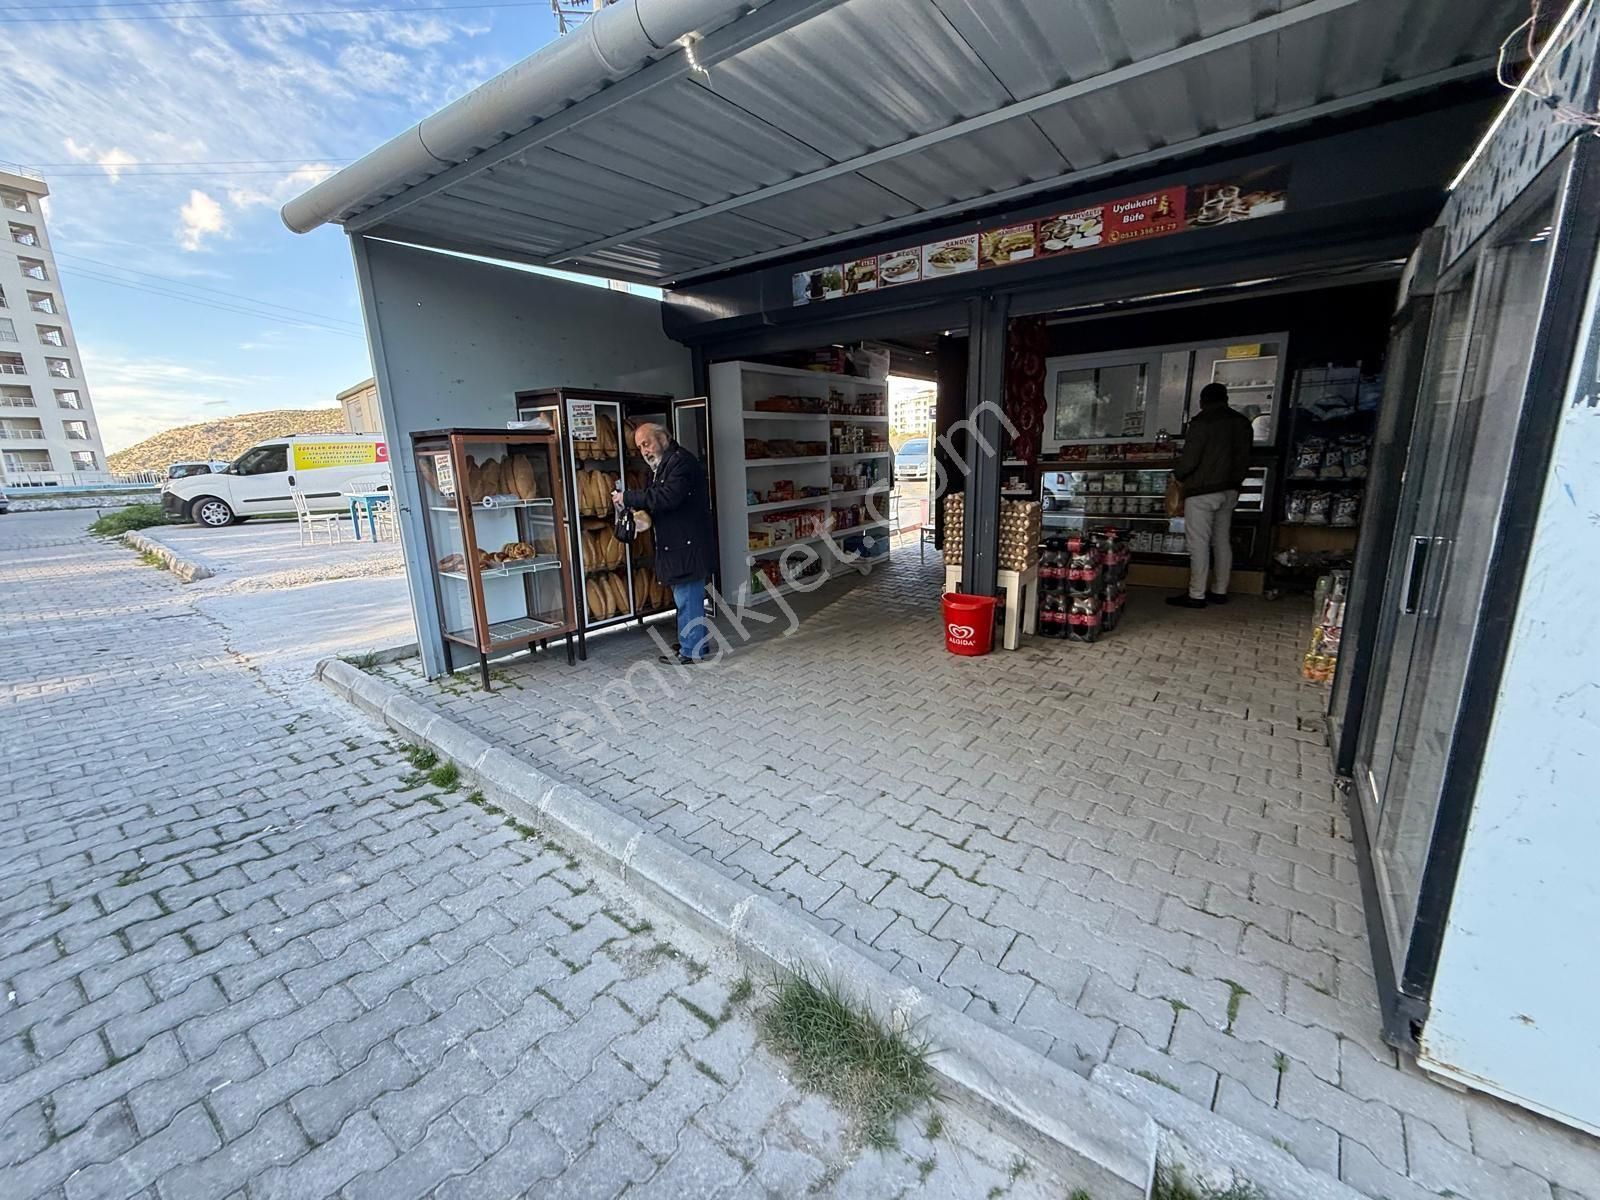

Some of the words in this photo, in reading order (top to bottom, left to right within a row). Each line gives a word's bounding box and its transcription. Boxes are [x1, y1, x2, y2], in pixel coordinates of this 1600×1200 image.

[1113, 197, 1157, 213] Uydukent
[1122, 212, 1144, 224] Büfe
[948, 637, 974, 647] ALGIDA
